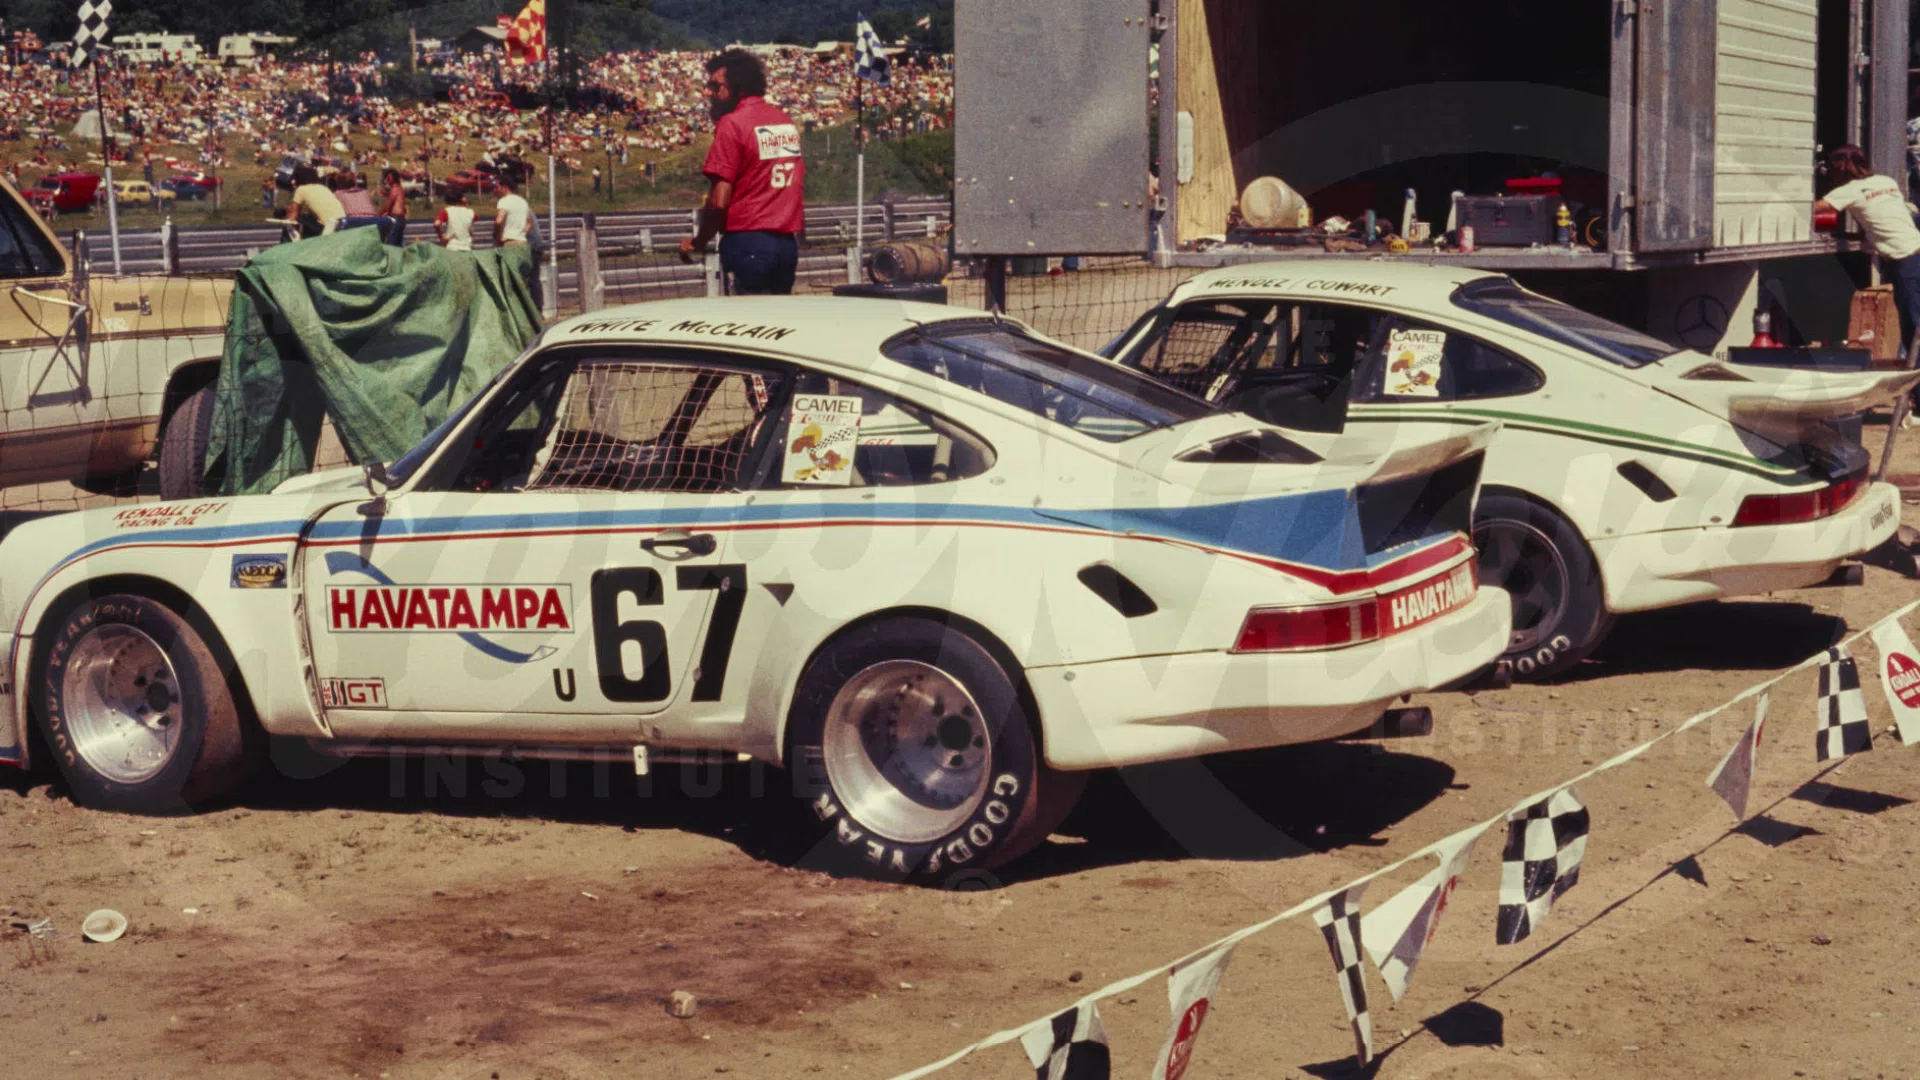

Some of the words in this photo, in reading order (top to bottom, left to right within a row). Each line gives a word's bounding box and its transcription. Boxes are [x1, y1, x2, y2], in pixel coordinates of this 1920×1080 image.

[771, 162, 795, 188] 67
[1306, 279, 1399, 296] COWART
[569, 320, 659, 333] WHITE
[669, 320, 796, 341] McCLAIN
[1392, 332, 1444, 344] CAMEL
[795, 397, 860, 414] CAMEL
[113, 504, 190, 521] KENDALL
[118, 517, 170, 529] RACING
[174, 515, 199, 526] OIL
[330, 587, 570, 629] HAVATAMPA
[589, 563, 748, 703] 67
[347, 682, 382, 704] GT
[553, 668, 577, 702] U
